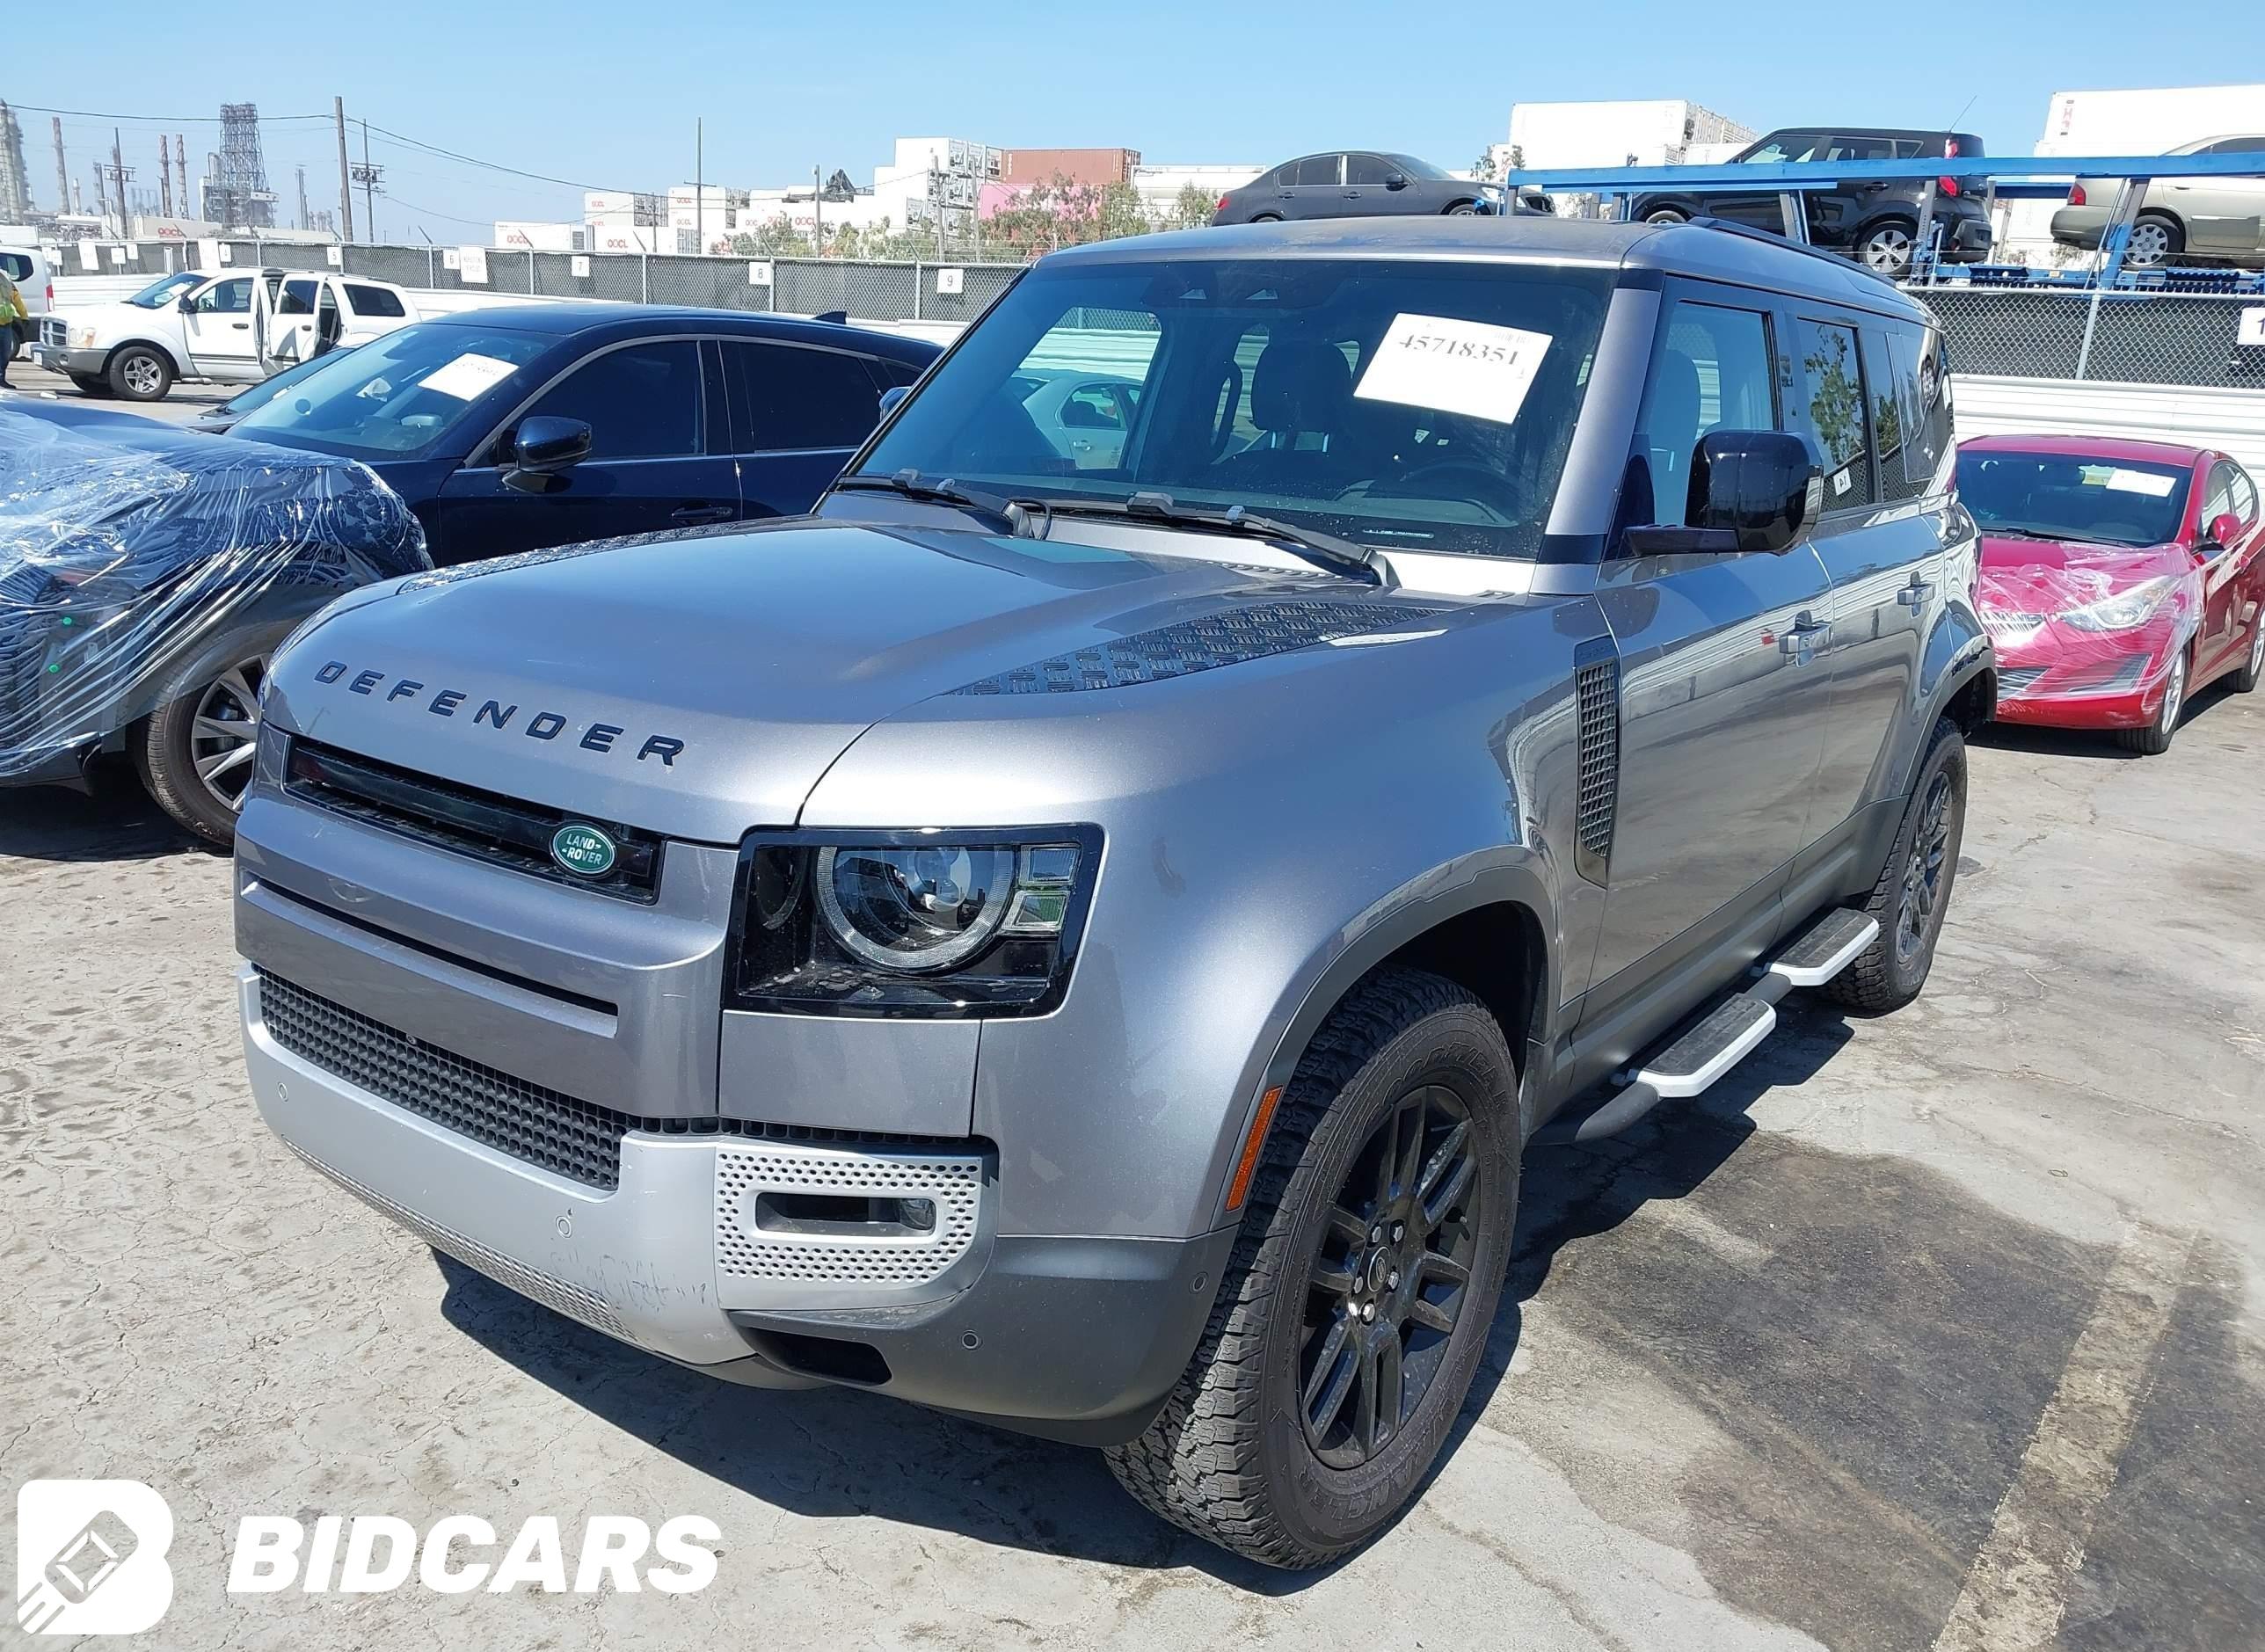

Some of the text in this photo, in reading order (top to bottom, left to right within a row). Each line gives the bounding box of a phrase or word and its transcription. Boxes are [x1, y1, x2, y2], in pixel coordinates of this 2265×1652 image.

[607, 239, 628, 249] OOCL
[947, 275, 953, 287] 9
[1399, 333, 1518, 366] 45718351
[314, 660, 685, 767] DEFENDER
